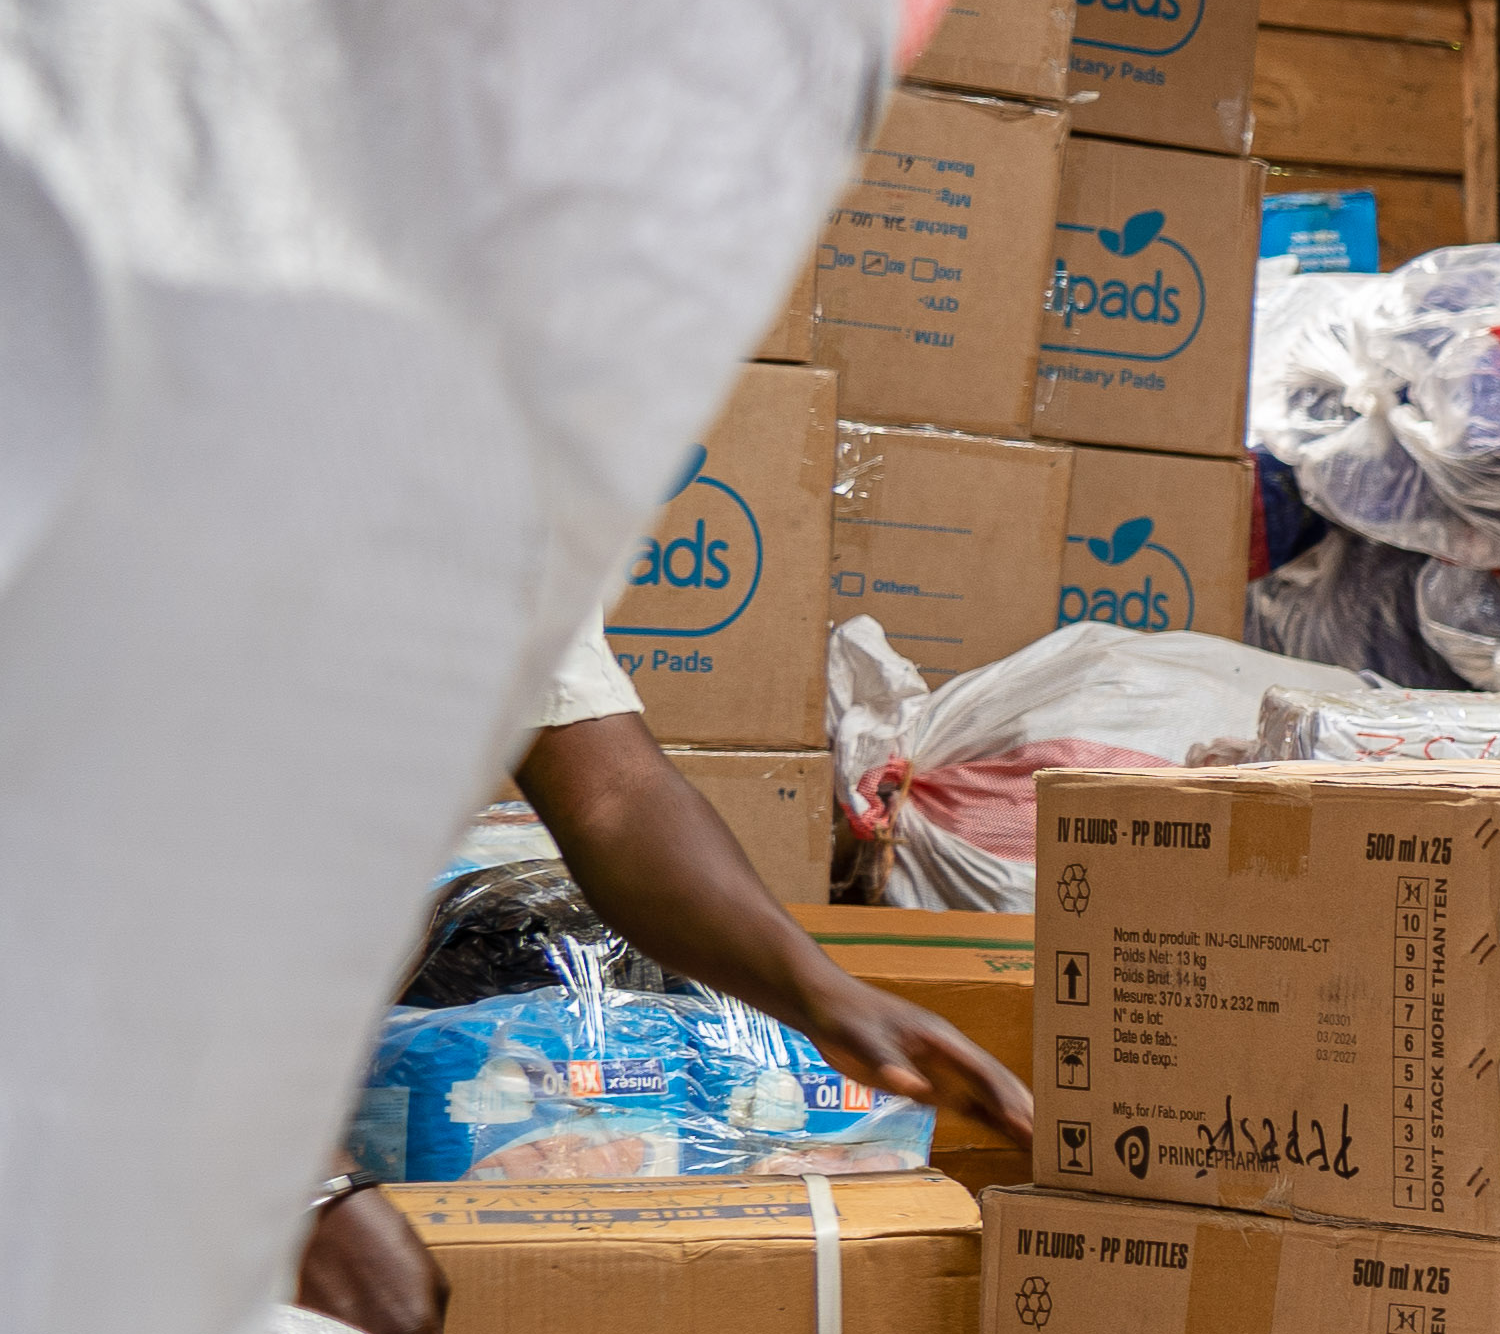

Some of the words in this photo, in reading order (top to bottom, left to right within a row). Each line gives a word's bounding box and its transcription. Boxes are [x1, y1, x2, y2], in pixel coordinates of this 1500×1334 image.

[652, 649, 714, 675] Pads
[1057, 818, 1070, 843] IV
[1074, 820, 1117, 845] FLUIDS
[1131, 821, 1150, 847] PP
[1154, 822, 1212, 850] BOTTLES
[1366, 833, 1395, 863] 500
[1399, 836, 1415, 862] ml
[1419, 842, 1429, 863] x
[1430, 837, 1452, 865] 25
[1433, 878, 1448, 922] TEN
[1114, 928, 1139, 945] Nom
[1143, 929, 1157, 945] du
[1160, 930, 1200, 949] produit:
[1205, 933, 1330, 954] INJ-GLINF500ML-CT
[1432, 927, 1446, 988] THAN
[1431, 992, 1445, 1058] MORE
[1431, 1066, 1445, 1139] STACK
[1431, 1145, 1445, 1213] DON'T
